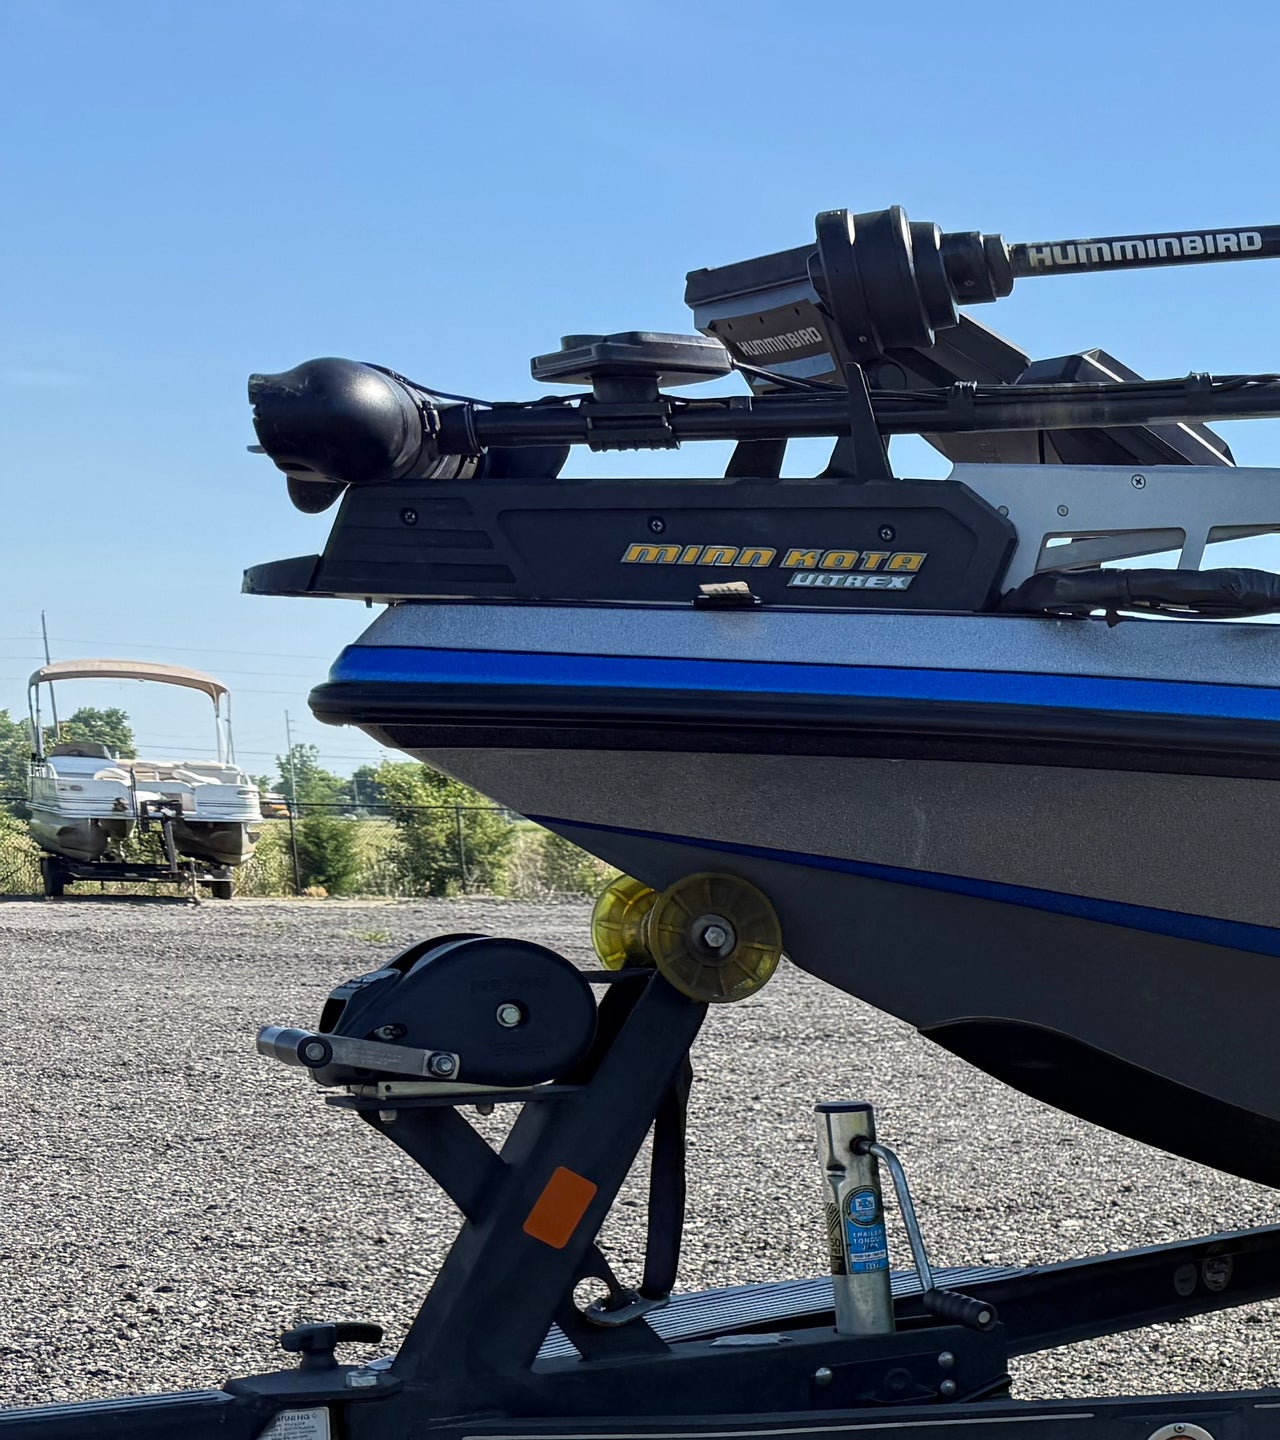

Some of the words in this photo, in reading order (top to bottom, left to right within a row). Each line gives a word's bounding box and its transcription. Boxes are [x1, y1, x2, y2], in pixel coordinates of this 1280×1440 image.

[1027, 231, 1263, 267] HUMMINBIRD
[736, 326, 823, 356] HUMMINBIRD
[621, 543, 777, 567] MINN
[779, 548, 928, 572] KOTA
[788, 572, 915, 590] ULTREX
